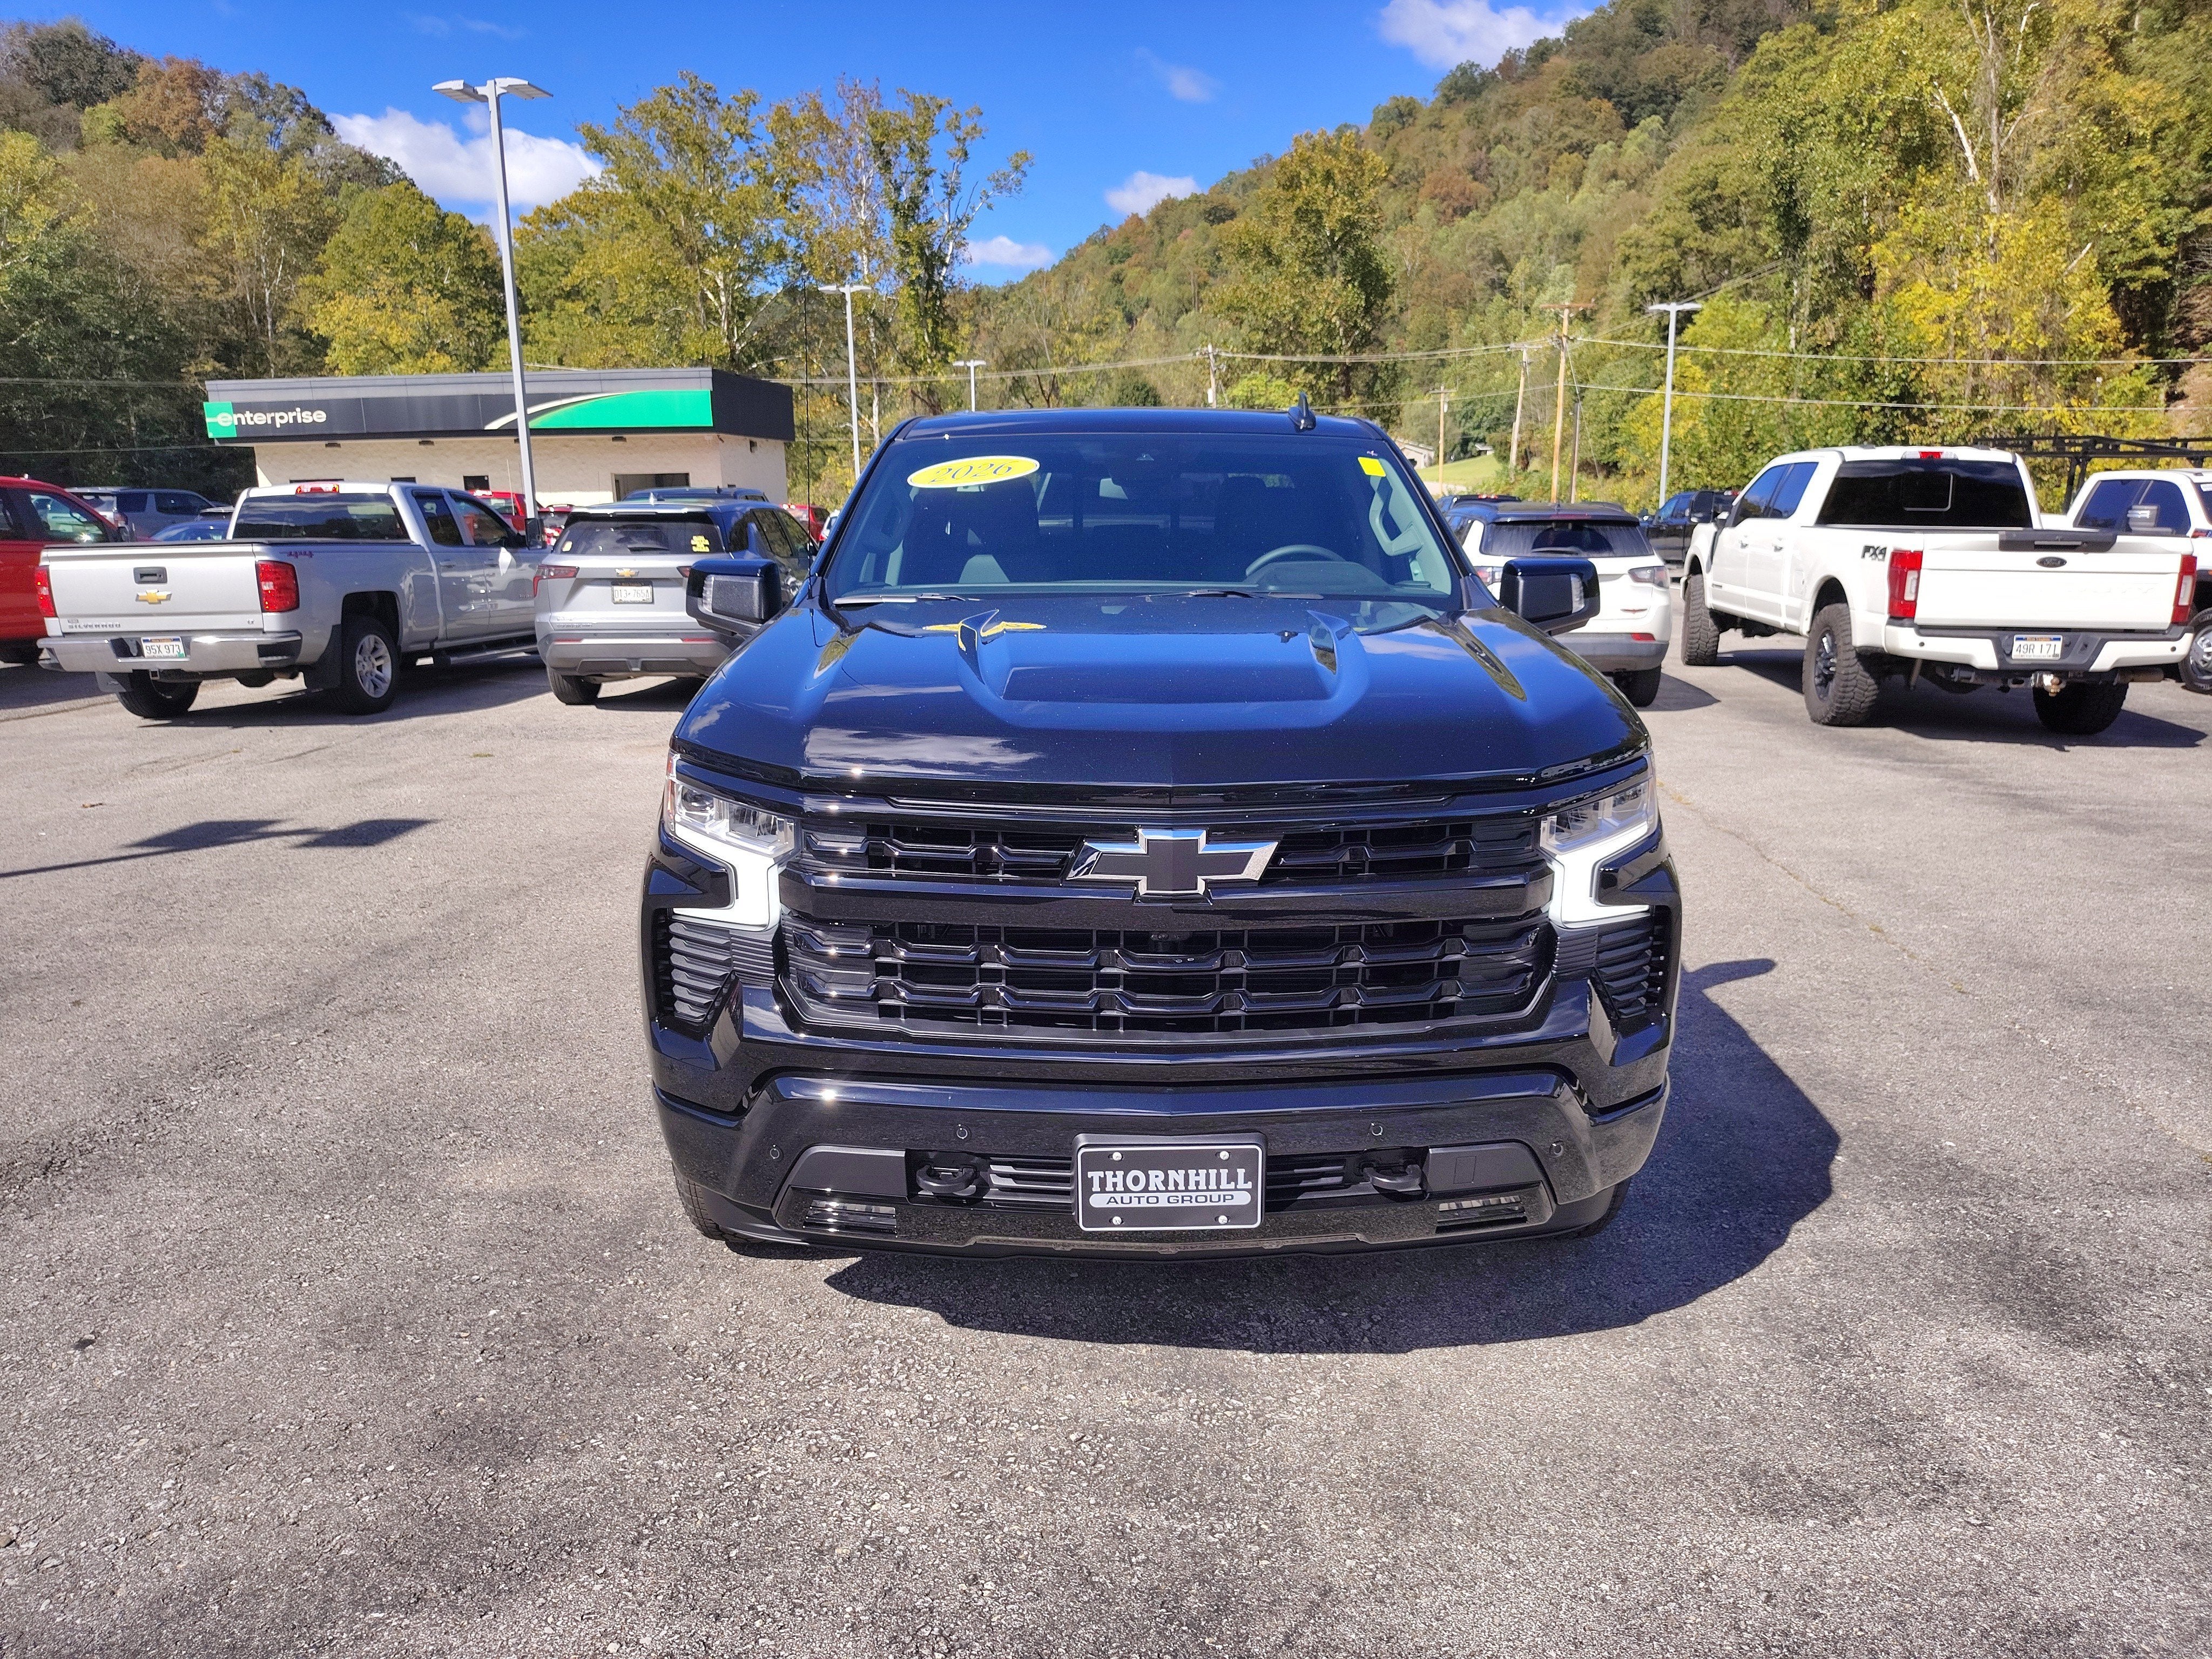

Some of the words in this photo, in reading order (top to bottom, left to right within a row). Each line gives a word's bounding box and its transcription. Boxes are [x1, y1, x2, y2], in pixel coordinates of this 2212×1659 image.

[217, 407, 327, 428] enterprise
[928, 461, 1019, 484] 2026
[1861, 545, 1887, 561] FX4
[145, 645, 163, 655] 95X
[164, 644, 181, 654] 973
[2016, 643, 2035, 654] 49R
[1087, 1168, 1252, 1192] THORNHILL
[1107, 1196, 1159, 1205] AUTO
[1166, 1194, 1234, 1204] GROUP
